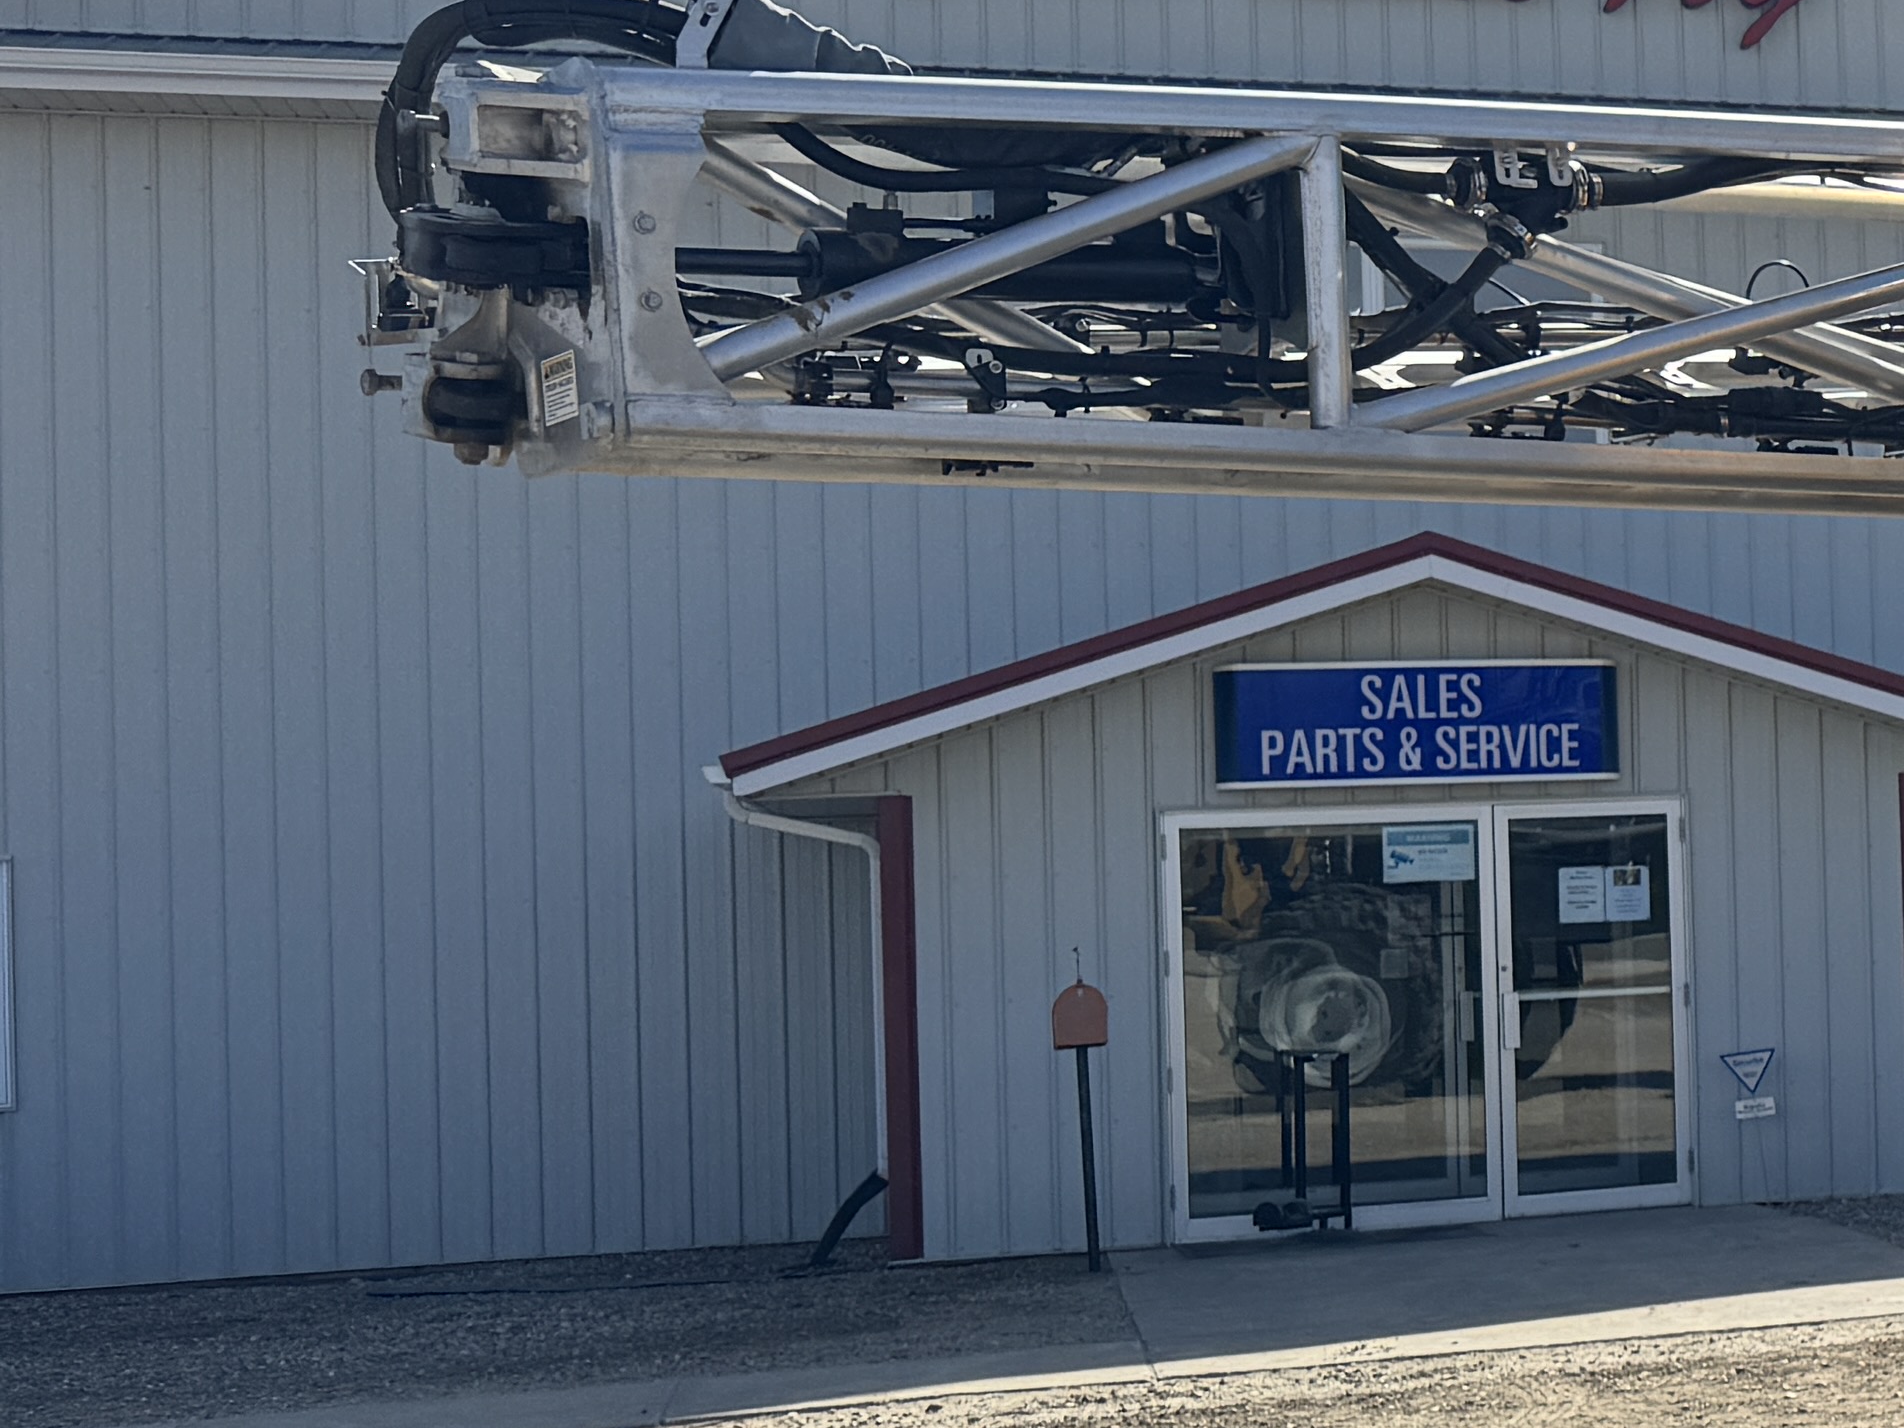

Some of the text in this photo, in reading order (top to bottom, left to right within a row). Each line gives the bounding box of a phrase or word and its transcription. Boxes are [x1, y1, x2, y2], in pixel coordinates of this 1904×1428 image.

[1360, 672, 1483, 721] SALES
[1260, 721, 1581, 775] PARTS & SERVICE
